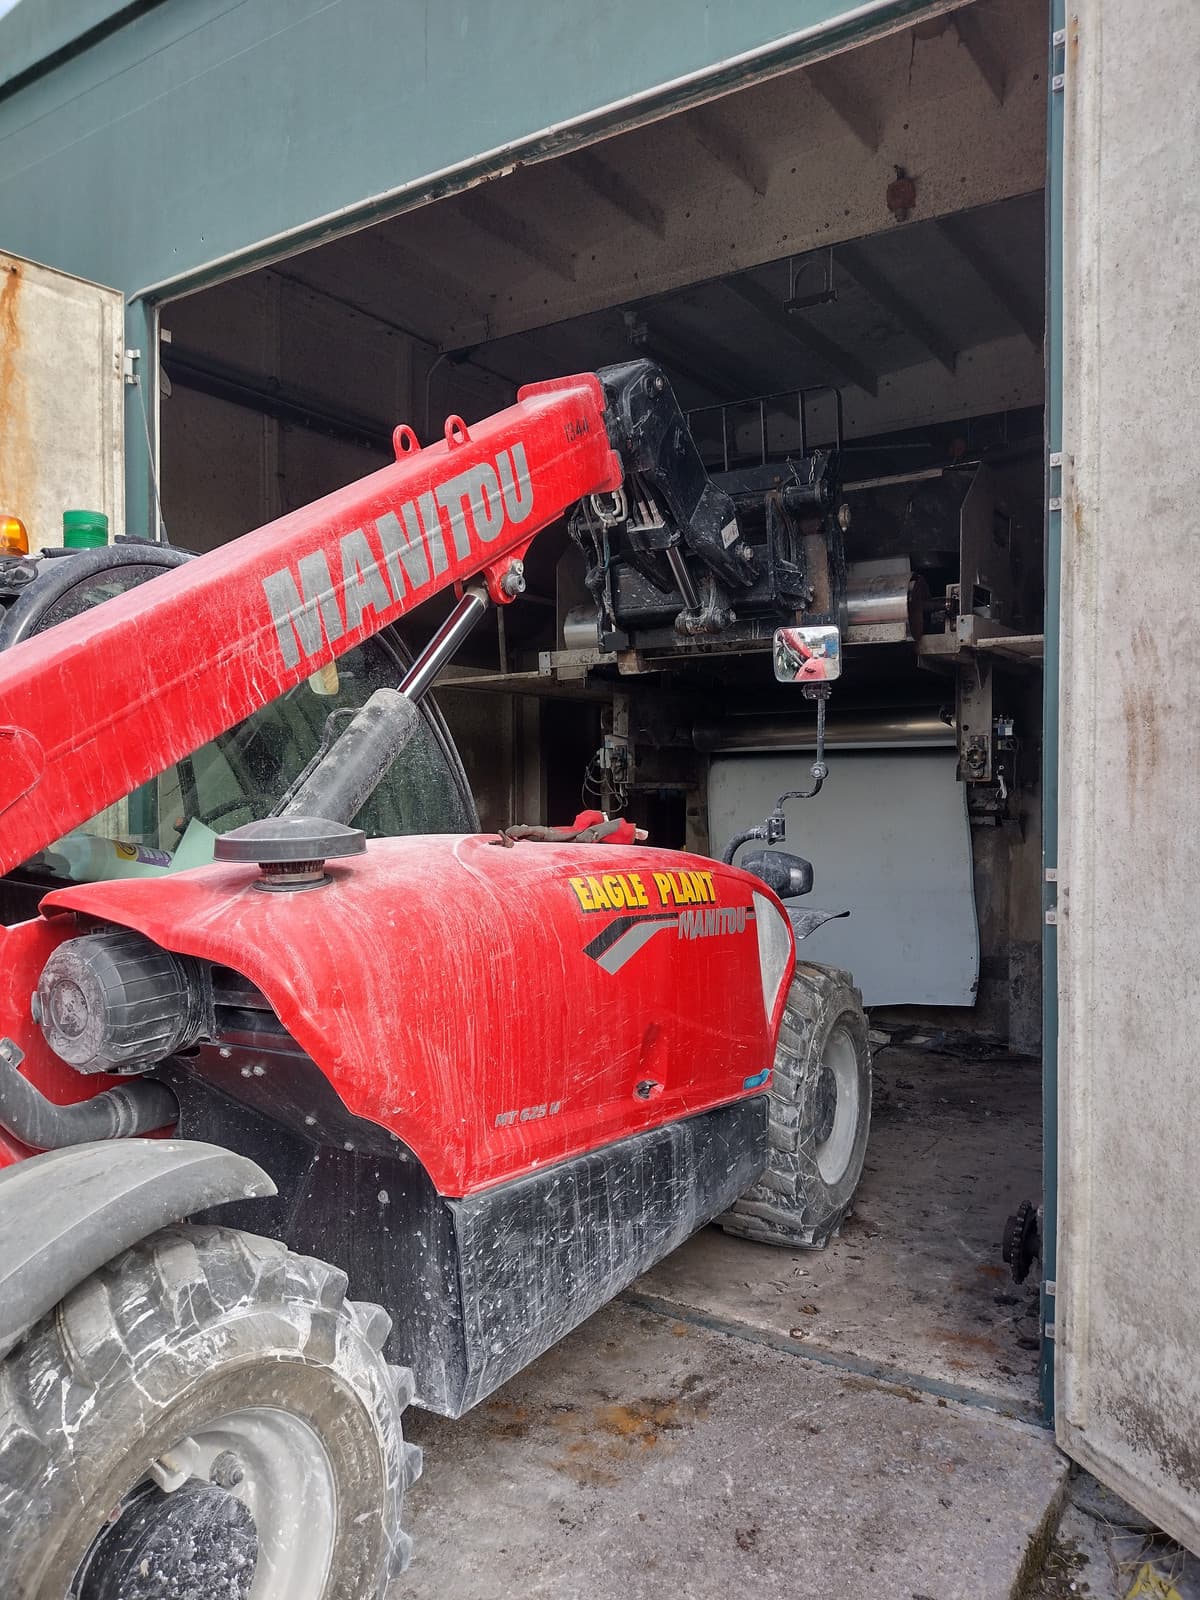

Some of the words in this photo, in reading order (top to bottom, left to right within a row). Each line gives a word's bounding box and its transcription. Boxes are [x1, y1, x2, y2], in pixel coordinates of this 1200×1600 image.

[262, 442, 534, 670] MANITOU
[568, 873, 648, 911] EAGLE
[653, 872, 716, 905] PLANT
[678, 908, 746, 939] MANITOU
[495, 1110, 518, 1127] MT
[519, 1103, 547, 1121] 625
